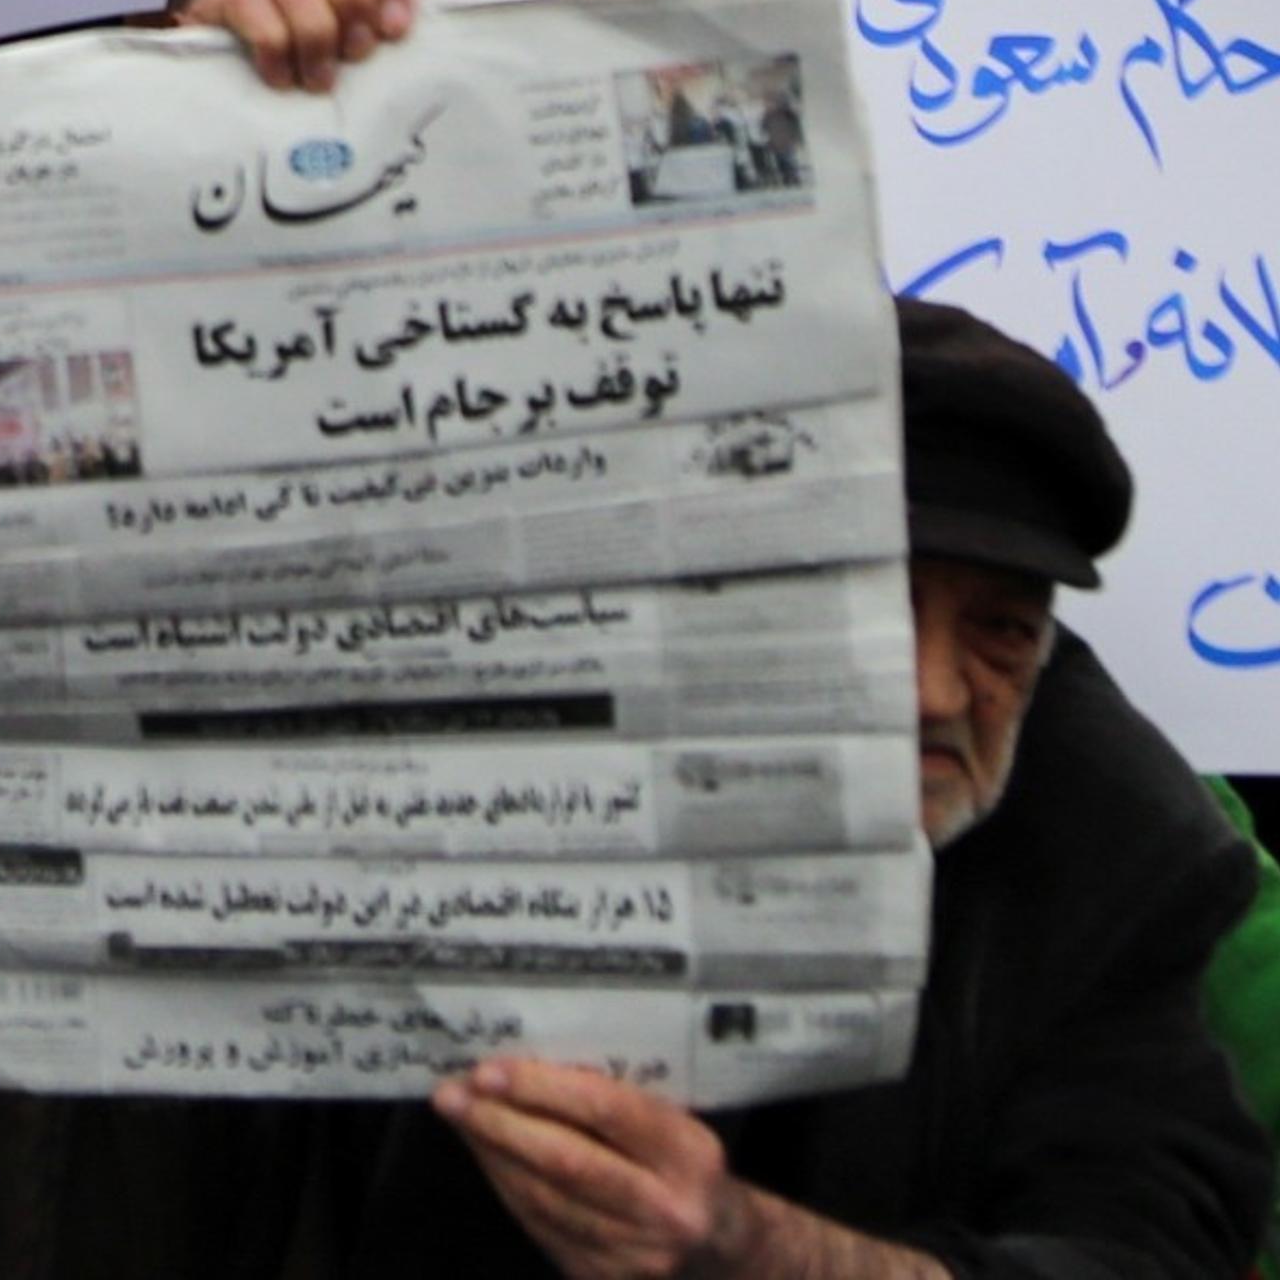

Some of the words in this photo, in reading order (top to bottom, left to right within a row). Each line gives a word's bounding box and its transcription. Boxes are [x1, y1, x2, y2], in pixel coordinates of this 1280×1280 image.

[186, 103, 450, 234] کیهان
[547, 297, 590, 345] به
[600, 273, 706, 341] پاسخ
[708, 263, 786, 322] تنها
[190, 307, 337, 381] آمریکا
[315, 384, 415, 437] است
[567, 352, 681, 418] توقف
